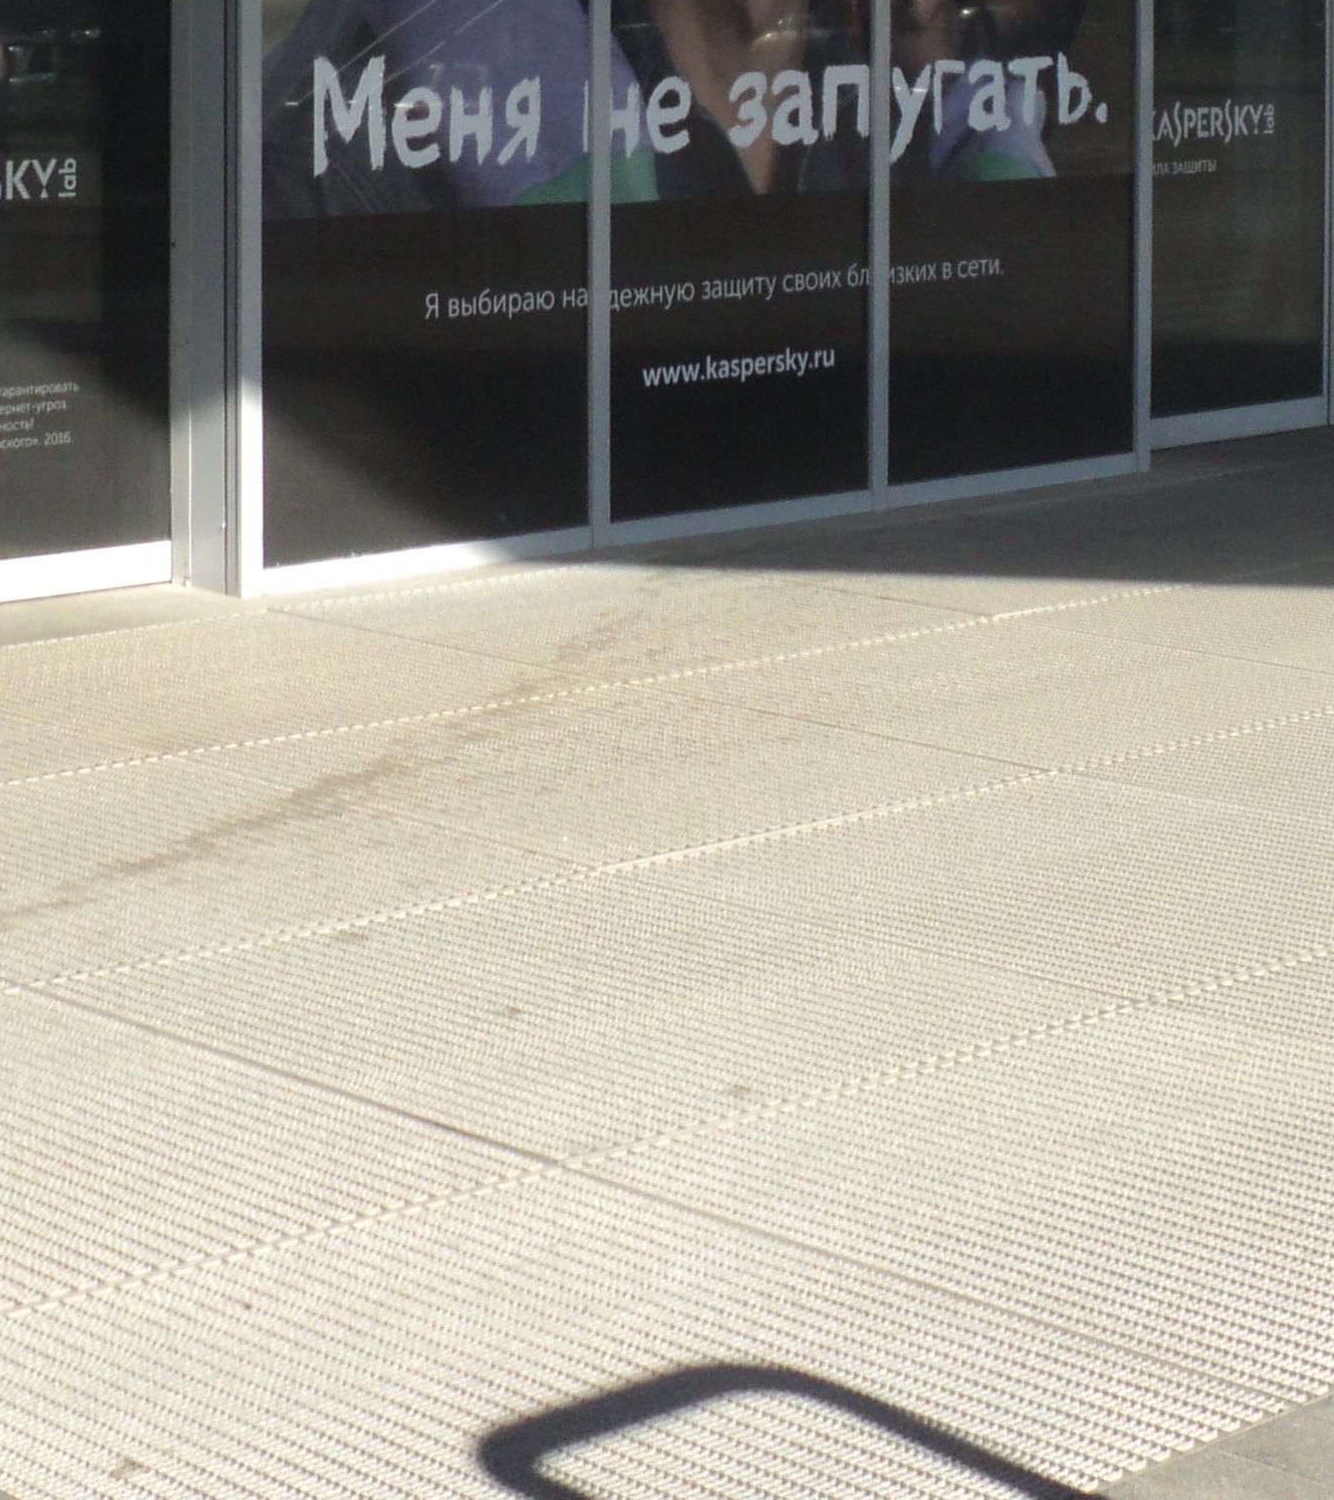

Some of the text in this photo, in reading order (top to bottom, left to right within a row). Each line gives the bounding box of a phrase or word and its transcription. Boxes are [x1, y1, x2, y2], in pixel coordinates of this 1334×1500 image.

[313, 51, 1108, 179] Меня не запугать.
[59, 158, 77, 198] lab
[425, 293, 440, 319] Я
[448, 288, 555, 320] выбираю
[702, 276, 776, 300] защиту
[782, 270, 841, 293] своих
[942, 261, 952, 279] в
[957, 257, 1004, 278] сети.
[642, 347, 835, 387] www.kaspersky.ru
